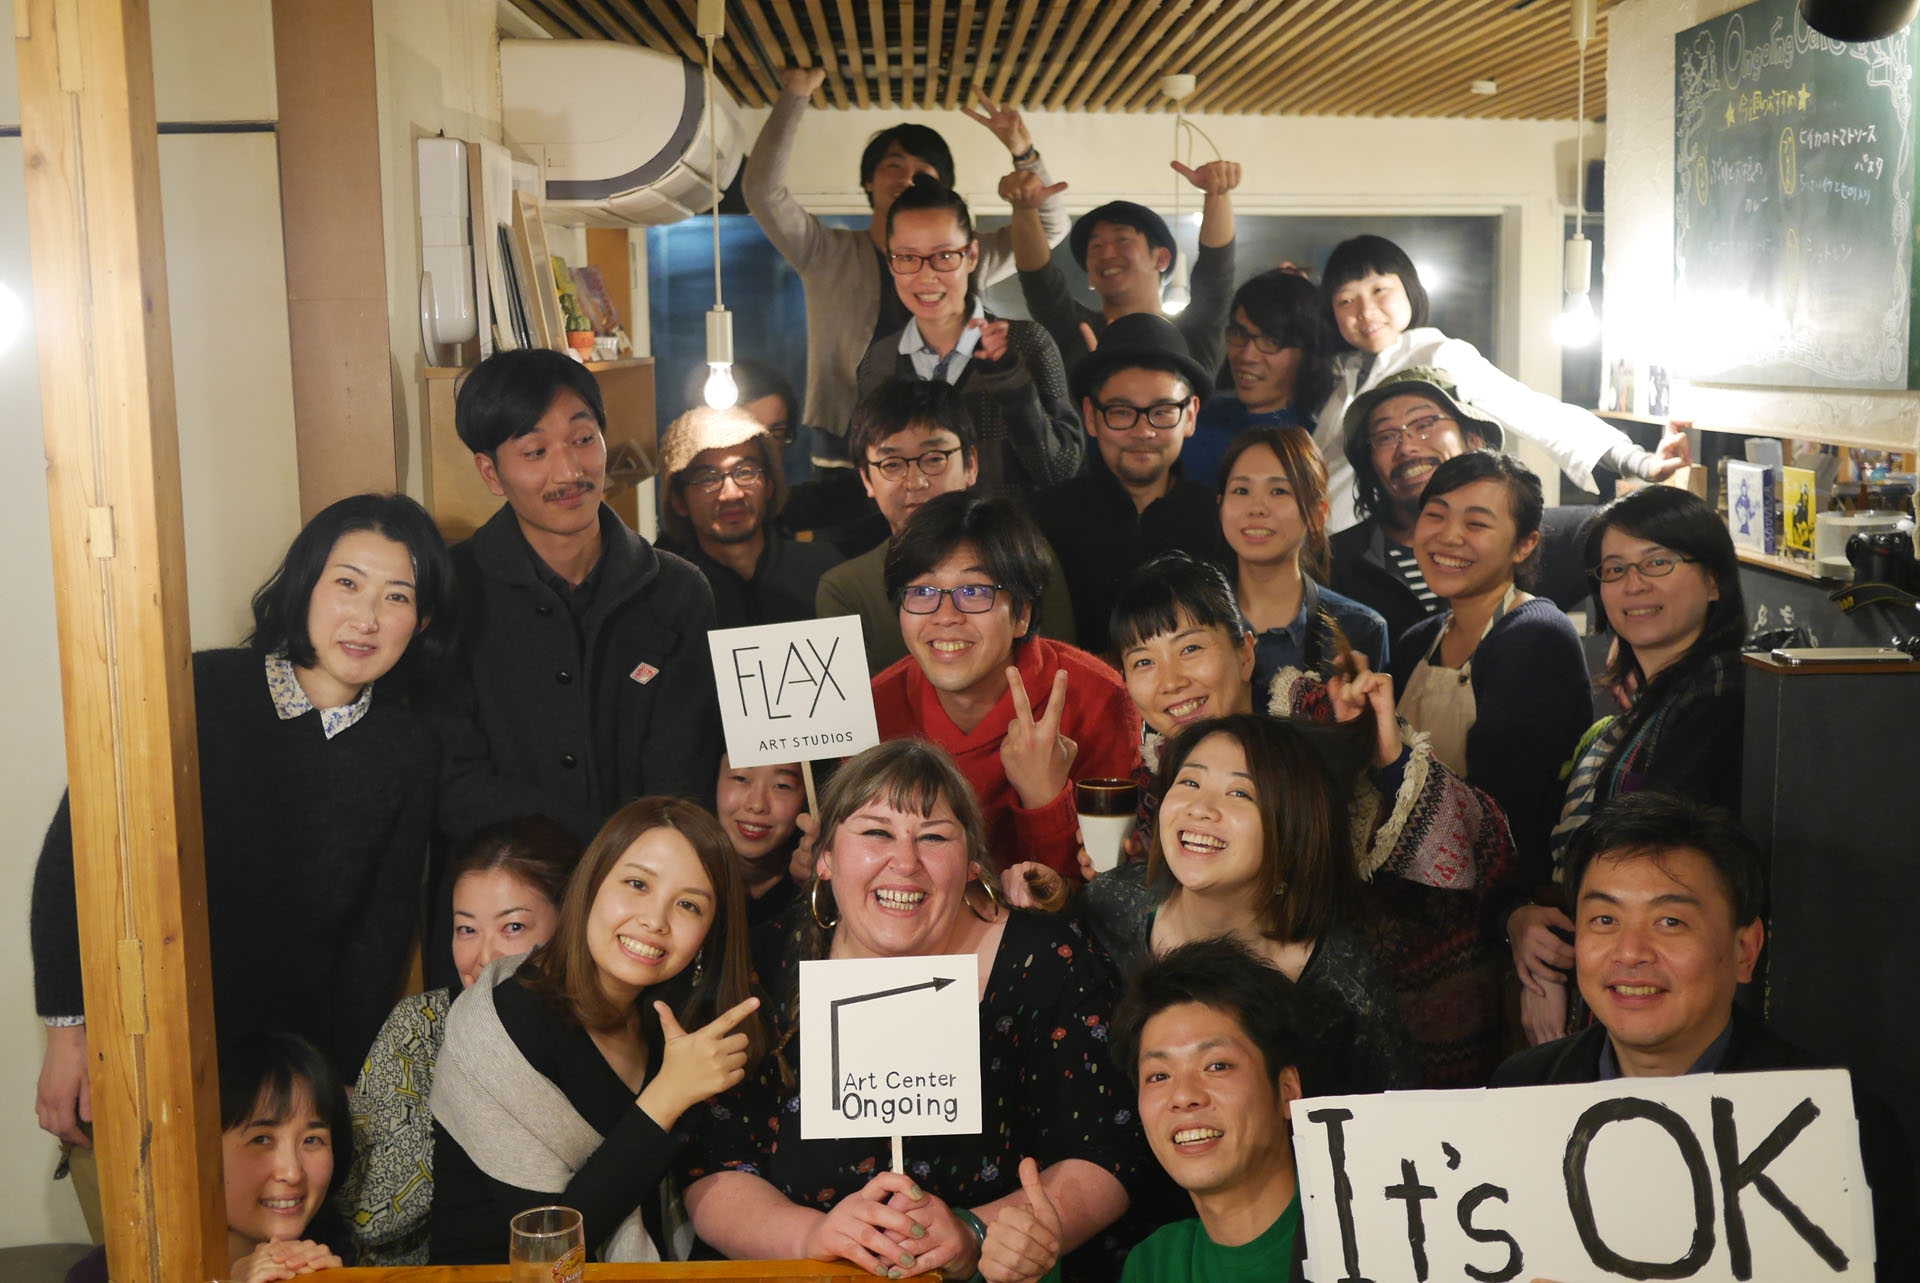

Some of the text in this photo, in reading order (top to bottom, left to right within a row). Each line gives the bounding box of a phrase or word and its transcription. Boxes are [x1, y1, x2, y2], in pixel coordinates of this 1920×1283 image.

[1723, 13, 1794, 90] Ongoing
[1854, 153, 1884, 180] パスタ
[732, 636, 846, 719] FLAX
[759, 731, 853, 751] ART STUDIOS
[843, 1071, 957, 1092] Art Center
[842, 1092, 958, 1124] Ongoing
[1307, 1094, 1850, 1283] It's OK
